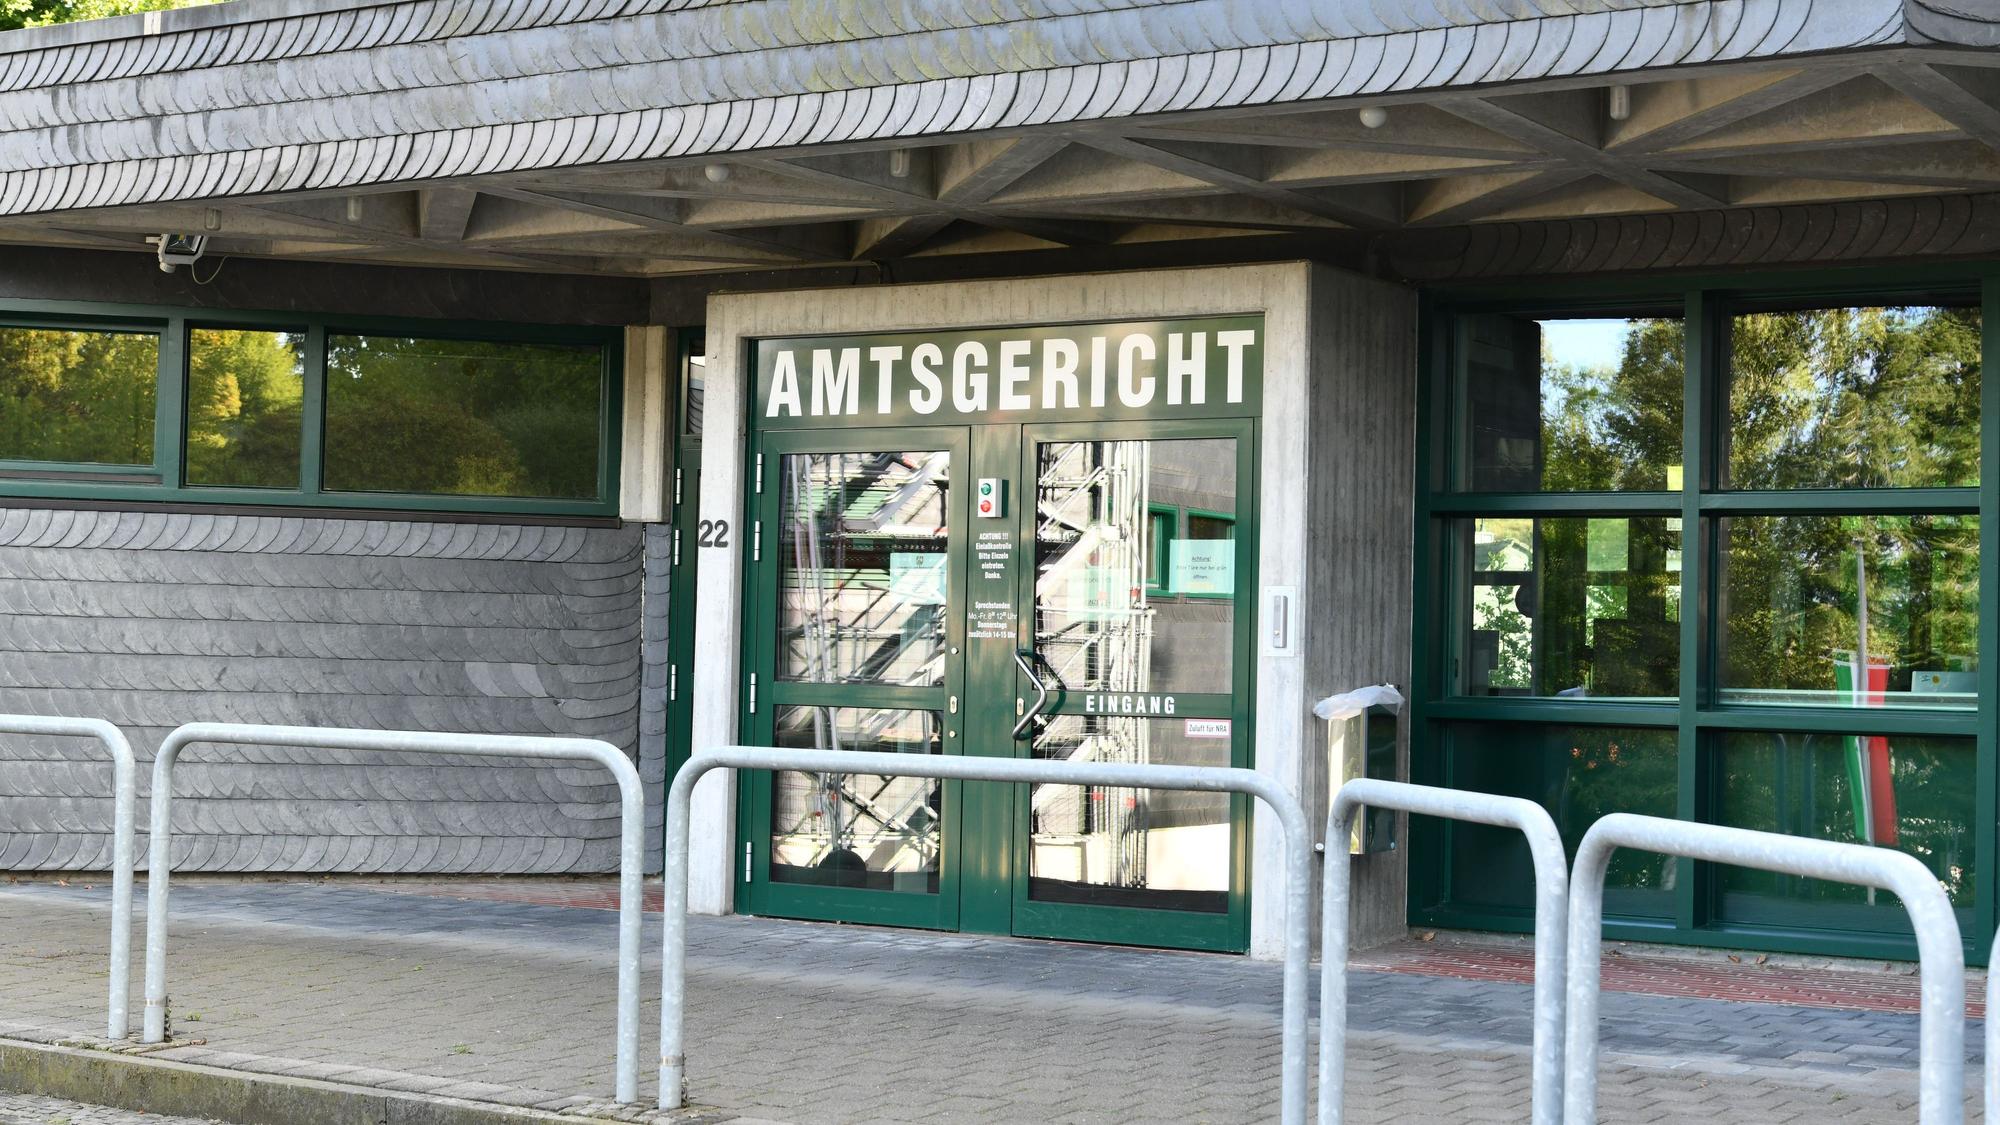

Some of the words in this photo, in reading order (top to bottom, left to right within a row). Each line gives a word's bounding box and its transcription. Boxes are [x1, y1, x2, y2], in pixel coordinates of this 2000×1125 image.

[765, 329, 1255, 418] AMTSGERICHT
[699, 519, 728, 547] 22
[979, 532, 1001, 540] ACHTUNG
[978, 552, 990, 560] Bitte
[984, 571, 1002, 579] Danke.
[975, 601, 1011, 610] Sprechstunden
[1007, 612, 1018, 620] Uhr
[977, 620, 1008, 630] Donnerstags
[1007, 631, 1016, 639] Uhr
[1086, 695, 1175, 714] EINGANG
